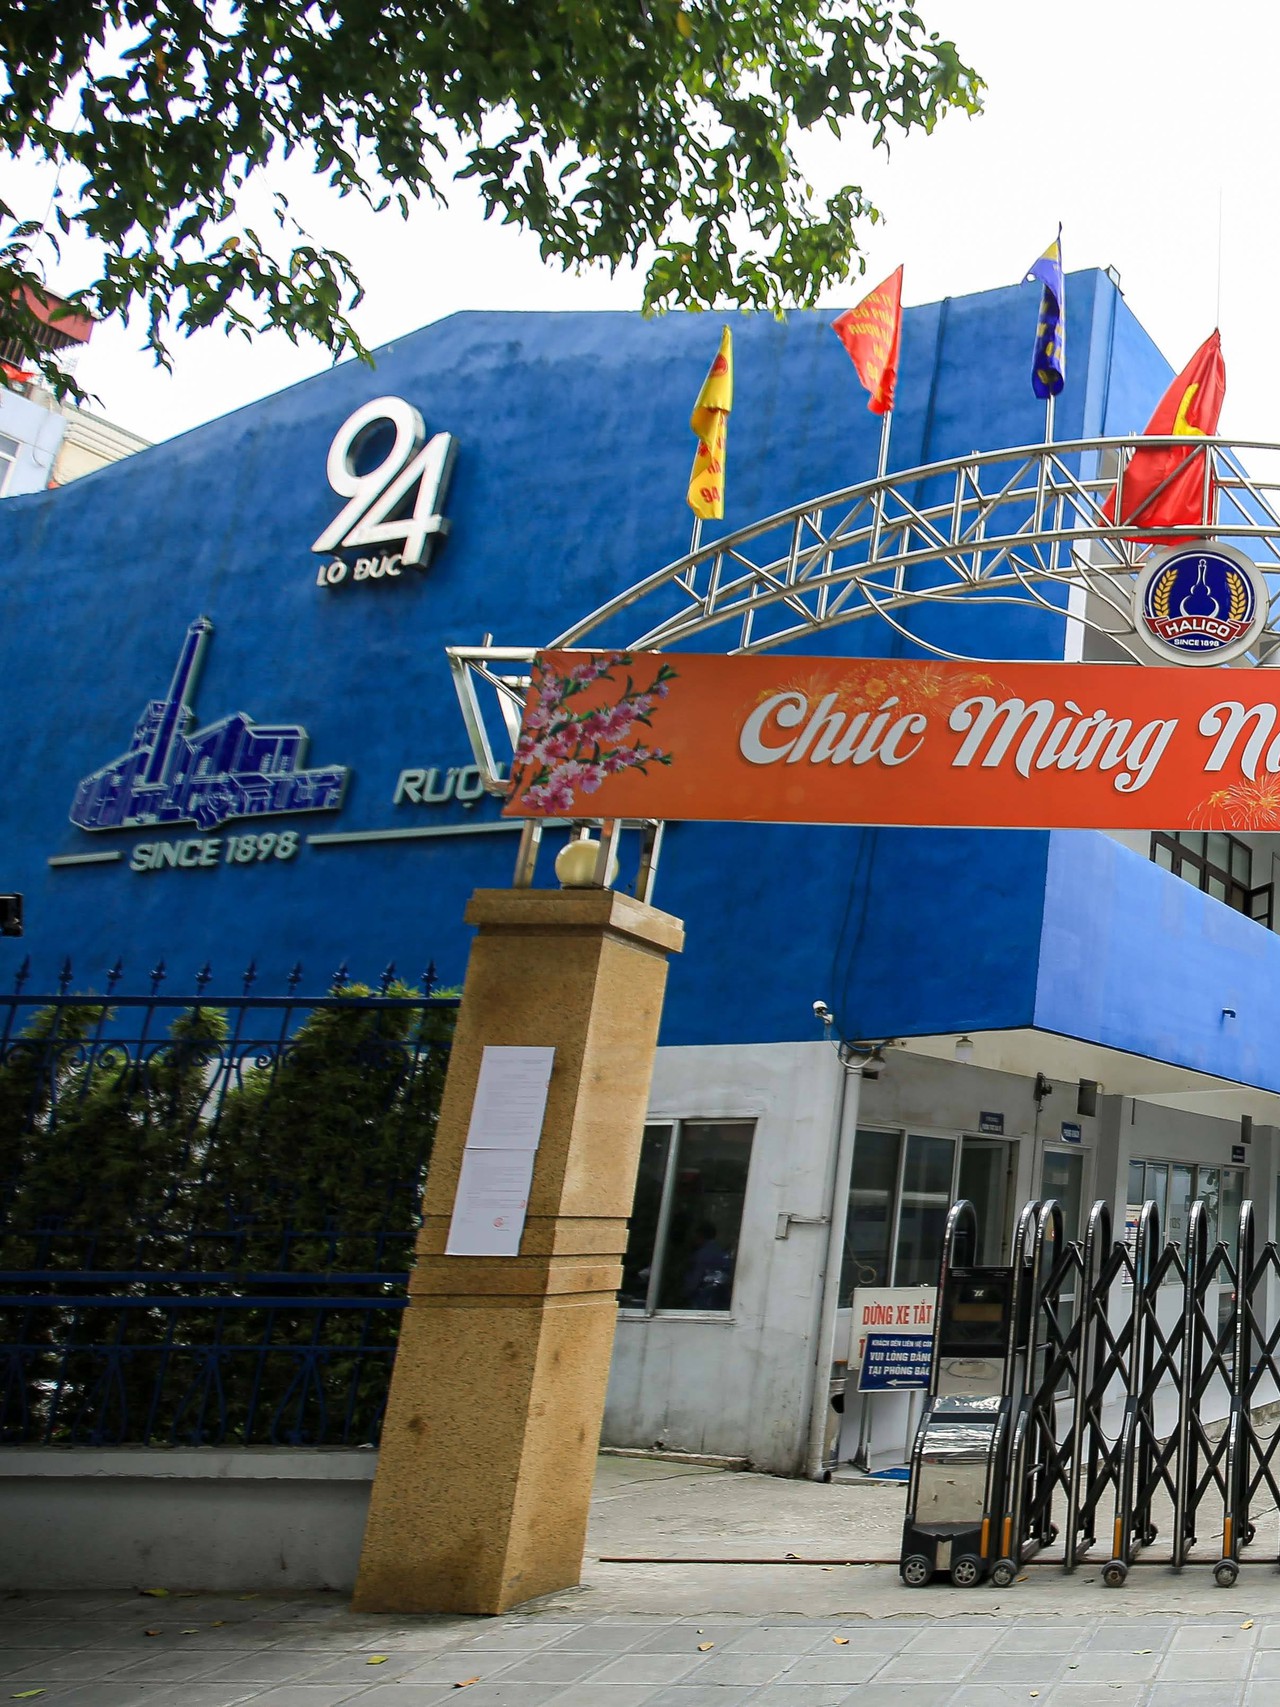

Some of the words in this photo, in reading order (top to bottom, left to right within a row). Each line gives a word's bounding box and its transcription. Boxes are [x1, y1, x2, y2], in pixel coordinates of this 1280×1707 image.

[311, 395, 453, 567] 94
[316, 556, 348, 586] LÒ
[1165, 618, 1231, 638] HALICO
[1174, 638, 1200, 646] SINCE
[1200, 639, 1220, 647] 1898
[739, 692, 928, 766] Chúc
[948, 695, 1179, 792] Mừng
[393, 762, 505, 808] RƯỢ
[130, 840, 222, 872] SINCE
[225, 832, 300, 864] 1898
[896, 1305, 910, 1325] XE
[870, 1352, 884, 1361] VUI
[886, 1350, 909, 1361] LÒNG
[868, 1365, 882, 1377] TẠI
[883, 1364, 913, 1375] PHÒNG
